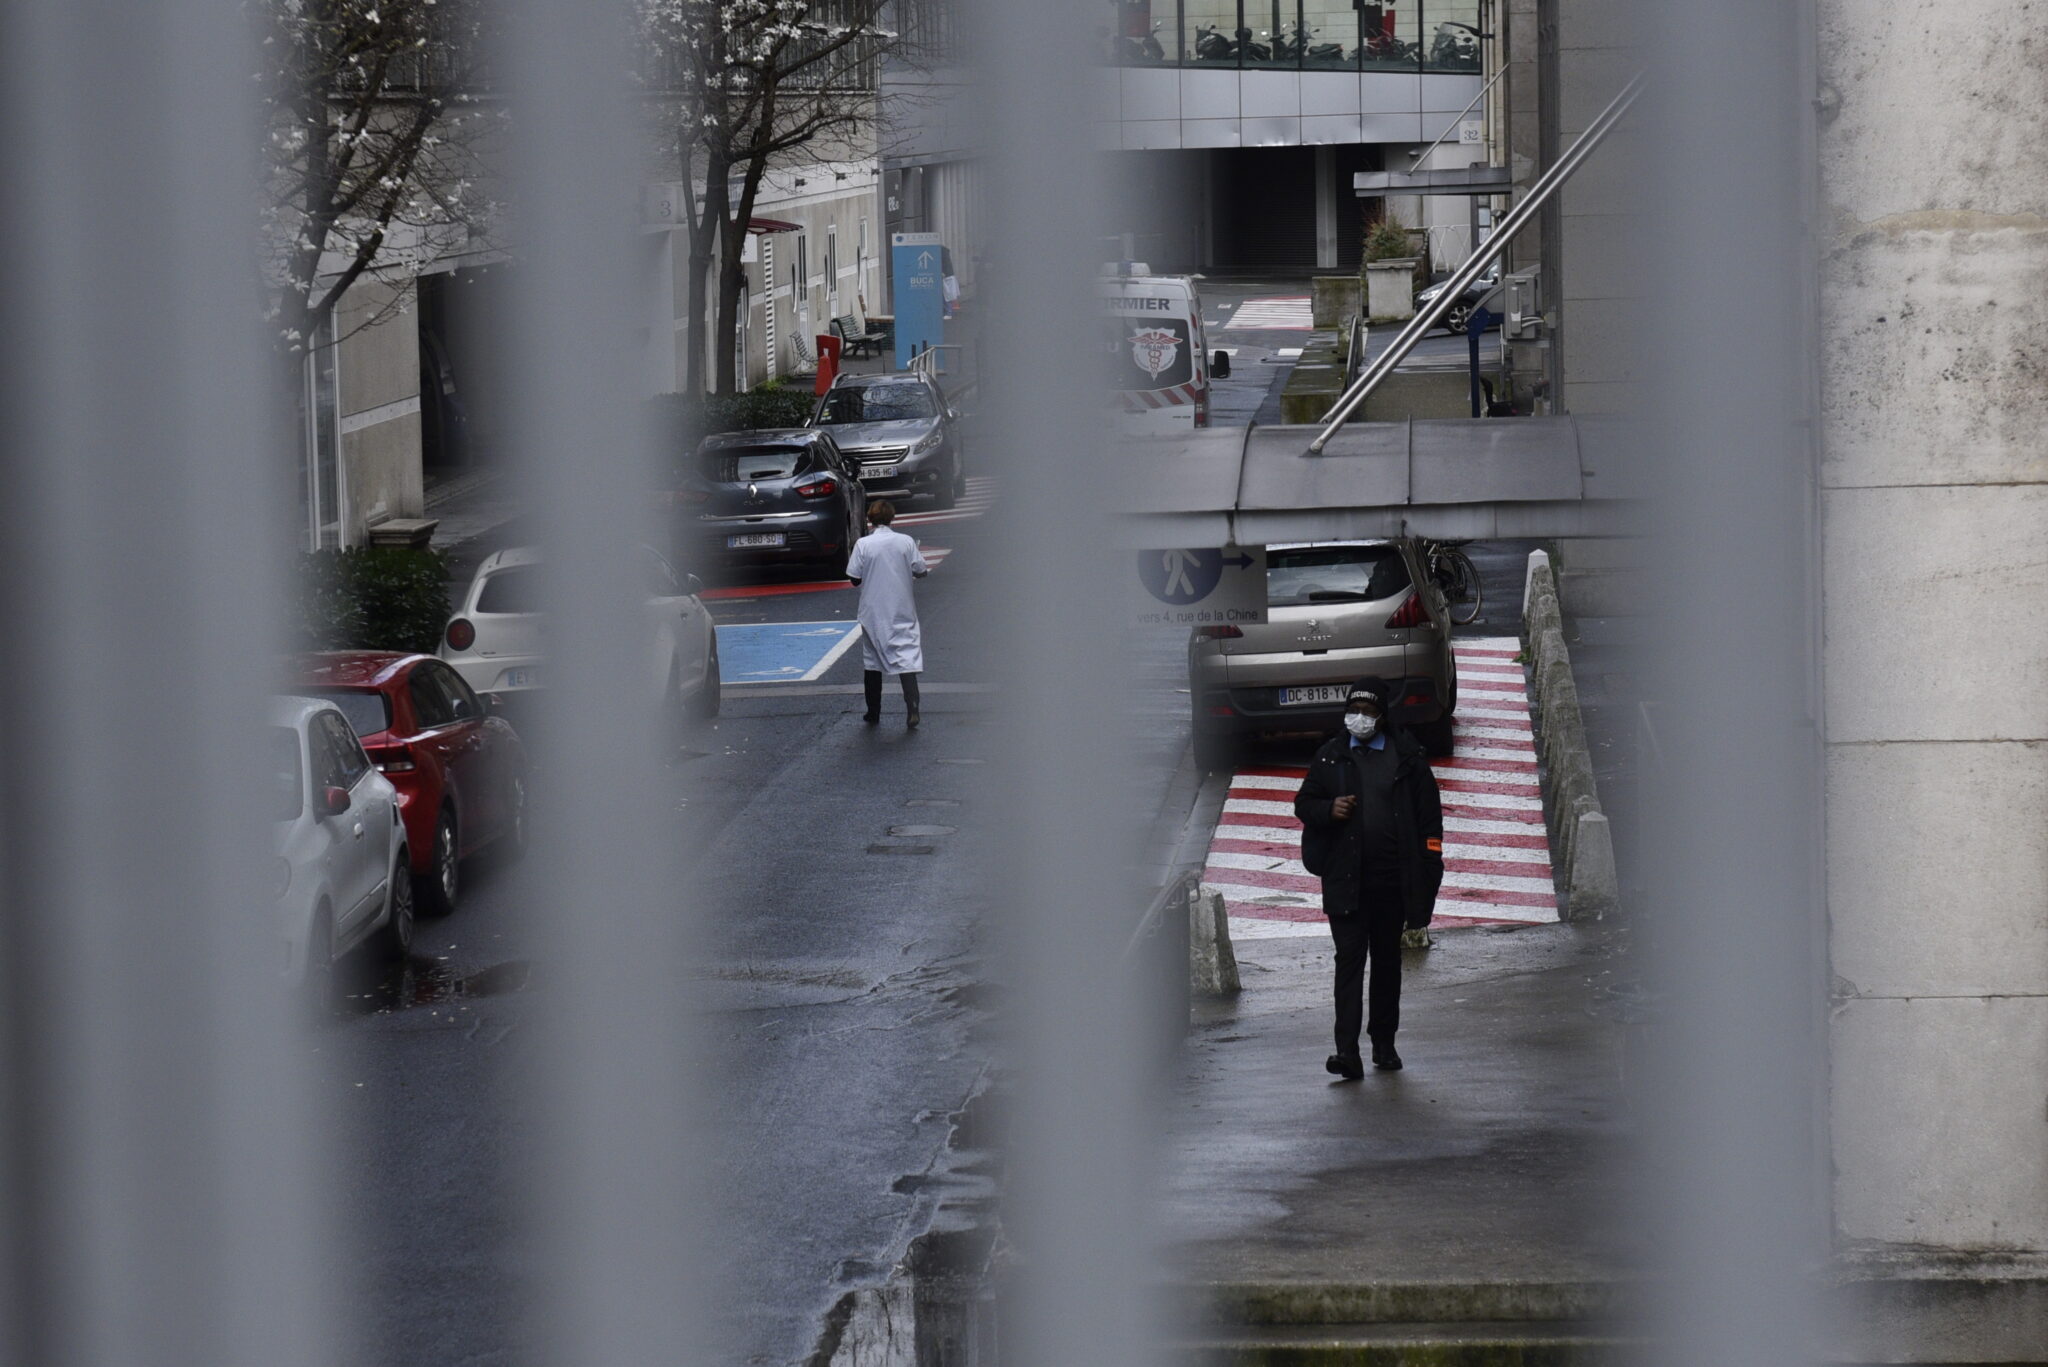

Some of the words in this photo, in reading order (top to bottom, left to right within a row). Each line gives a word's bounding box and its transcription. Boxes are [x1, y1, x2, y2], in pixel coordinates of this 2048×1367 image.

[1464, 129, 1478, 141] 32
[910, 277, 934, 285] BUCA
[1136, 614, 1160, 623] vers
[1177, 612, 1194, 623] rue
[1198, 610, 1211, 621] de
[1214, 610, 1224, 621] la
[1227, 609, 1258, 621] Chine
[1288, 686, 1348, 702] DC-818-YV
[1351, 690, 1378, 700] SECURITY
